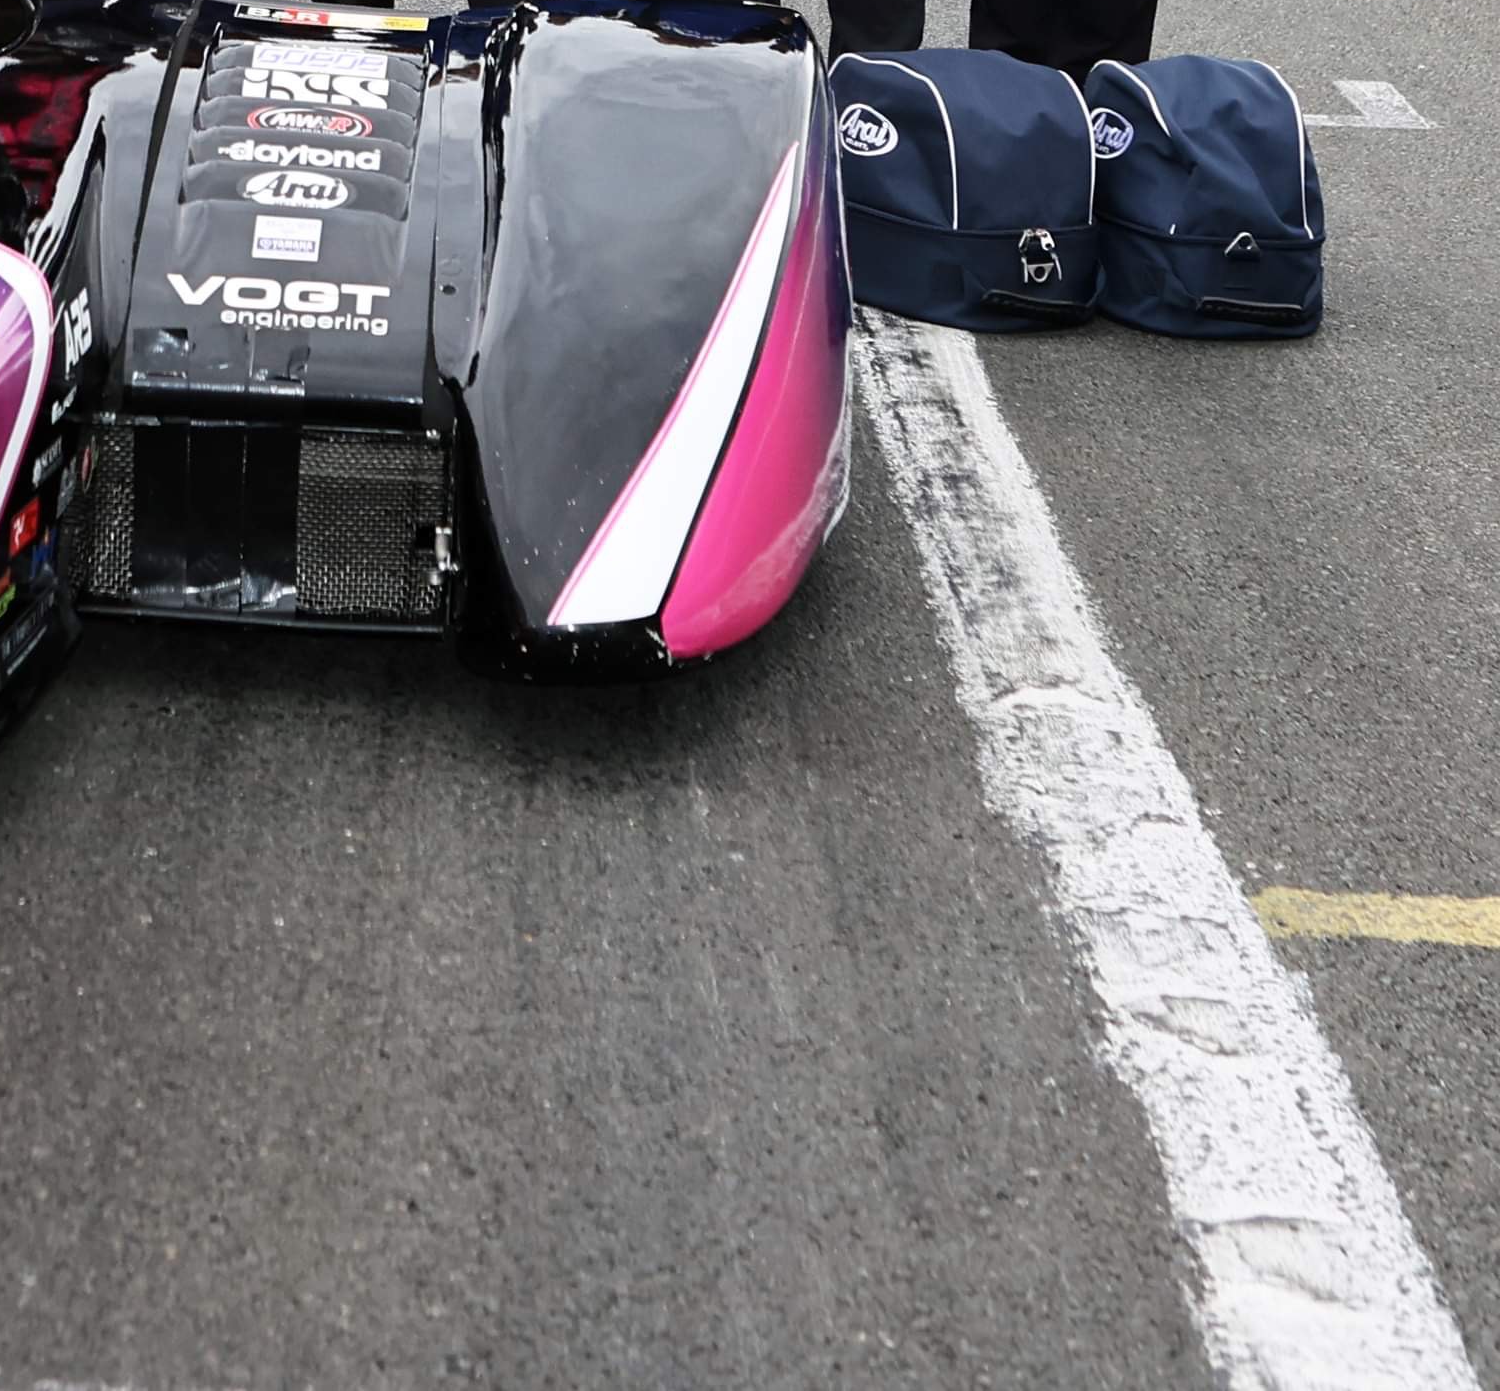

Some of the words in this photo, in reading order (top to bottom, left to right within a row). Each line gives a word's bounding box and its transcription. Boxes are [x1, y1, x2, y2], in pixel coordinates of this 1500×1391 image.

[840, 108, 889, 147] Arai
[229, 139, 381, 170] daytona
[243, 172, 344, 201] Arai
[272, 239, 314, 252] YAMAHA
[166, 273, 391, 316] VOGT
[220, 309, 389, 336] engineering
